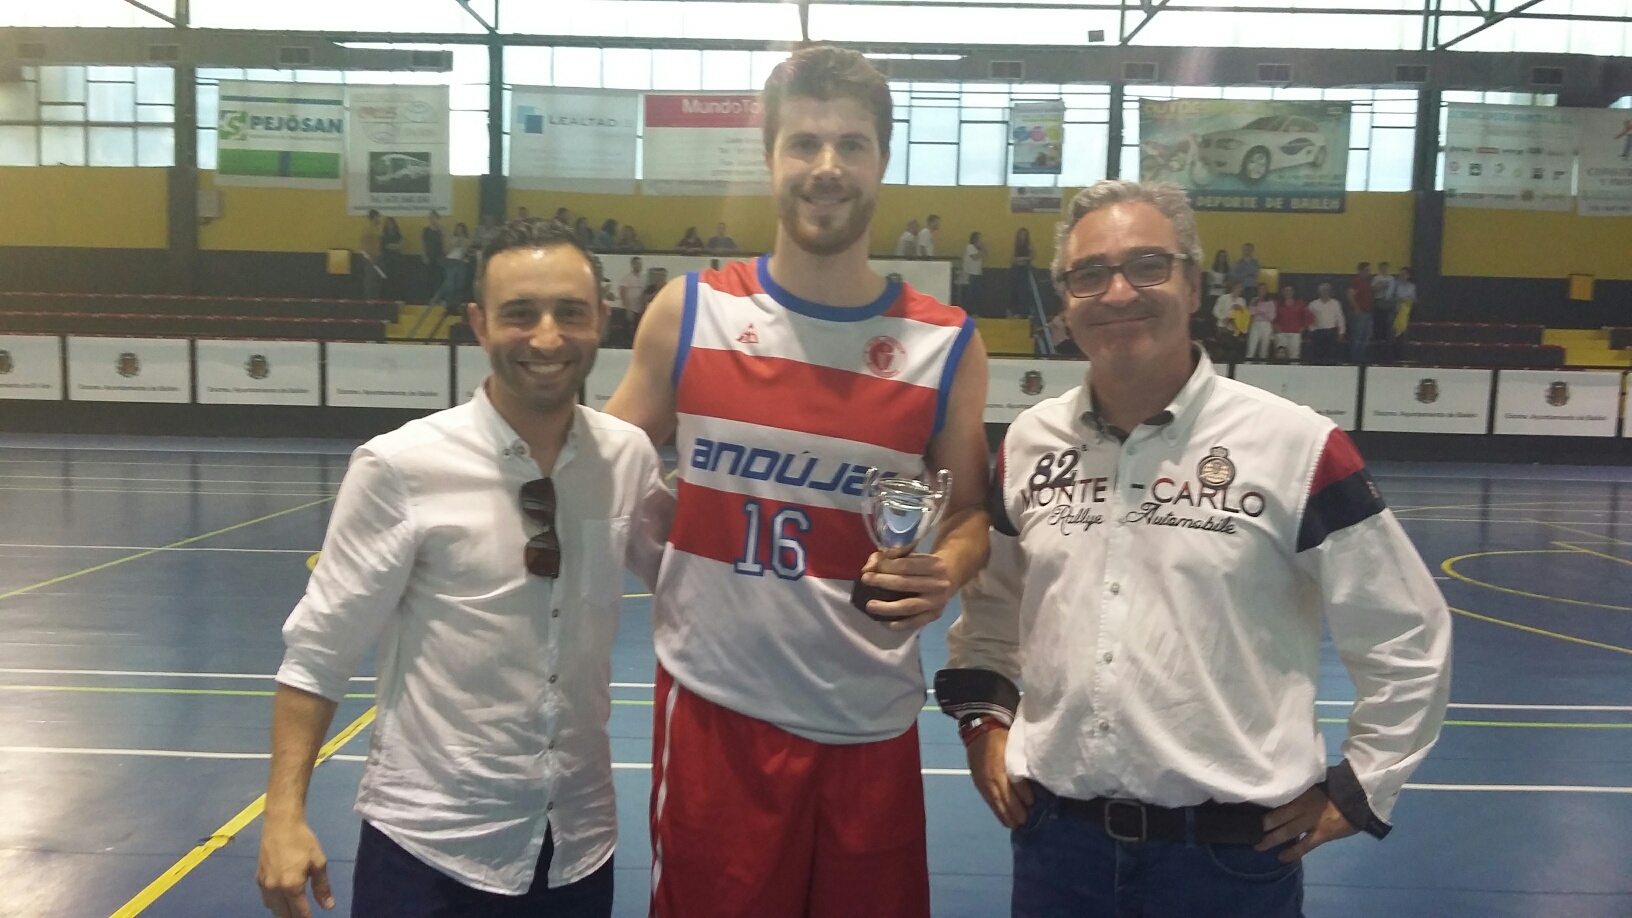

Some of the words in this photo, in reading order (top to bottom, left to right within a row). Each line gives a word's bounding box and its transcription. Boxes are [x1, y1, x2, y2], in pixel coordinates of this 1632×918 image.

[1014, 476, 1109, 510] MONTE
[1151, 477, 1266, 518] CARLO
[1047, 504, 1105, 536] Rallye
[1117, 502, 1238, 536] Automobile
[734, 501, 812, 581] 16
